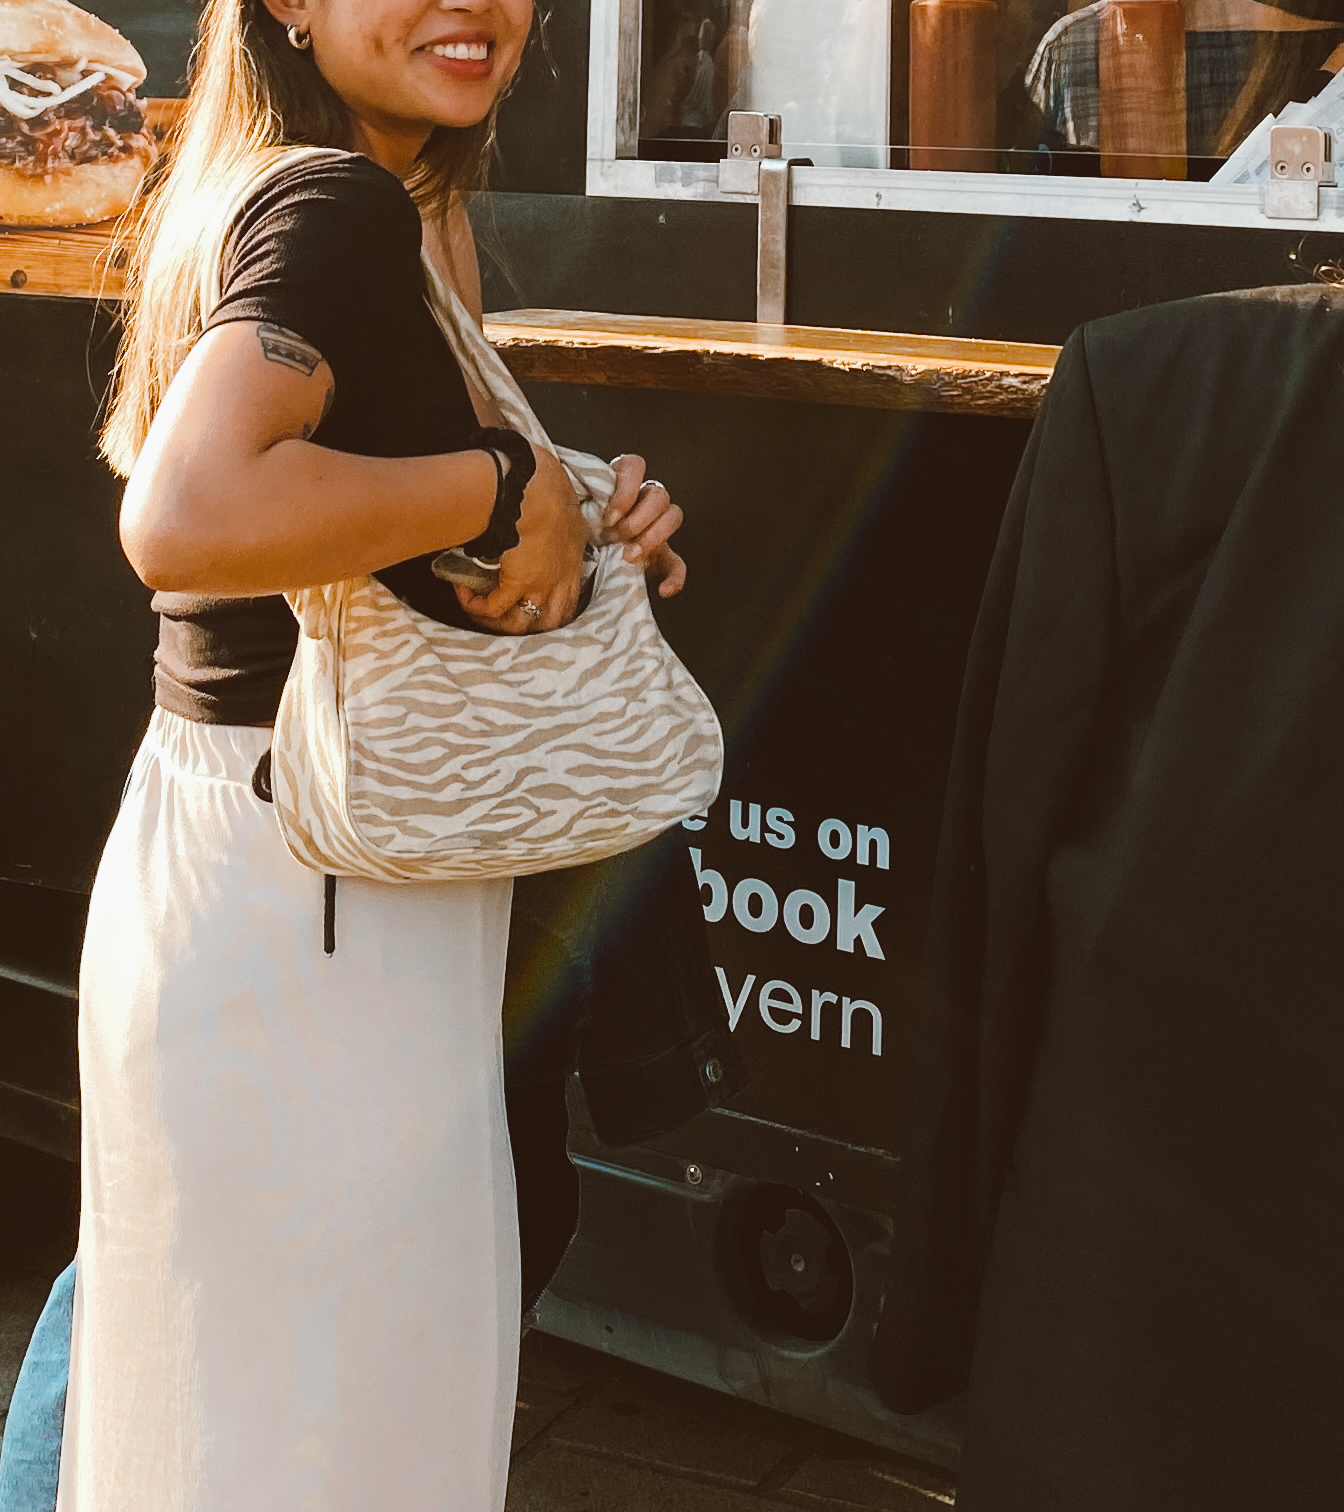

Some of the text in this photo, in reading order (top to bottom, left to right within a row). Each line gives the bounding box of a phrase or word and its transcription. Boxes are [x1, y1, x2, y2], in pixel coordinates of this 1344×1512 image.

[729, 799, 796, 849] us
[817, 818, 890, 870] on
[688, 846, 886, 961] book
